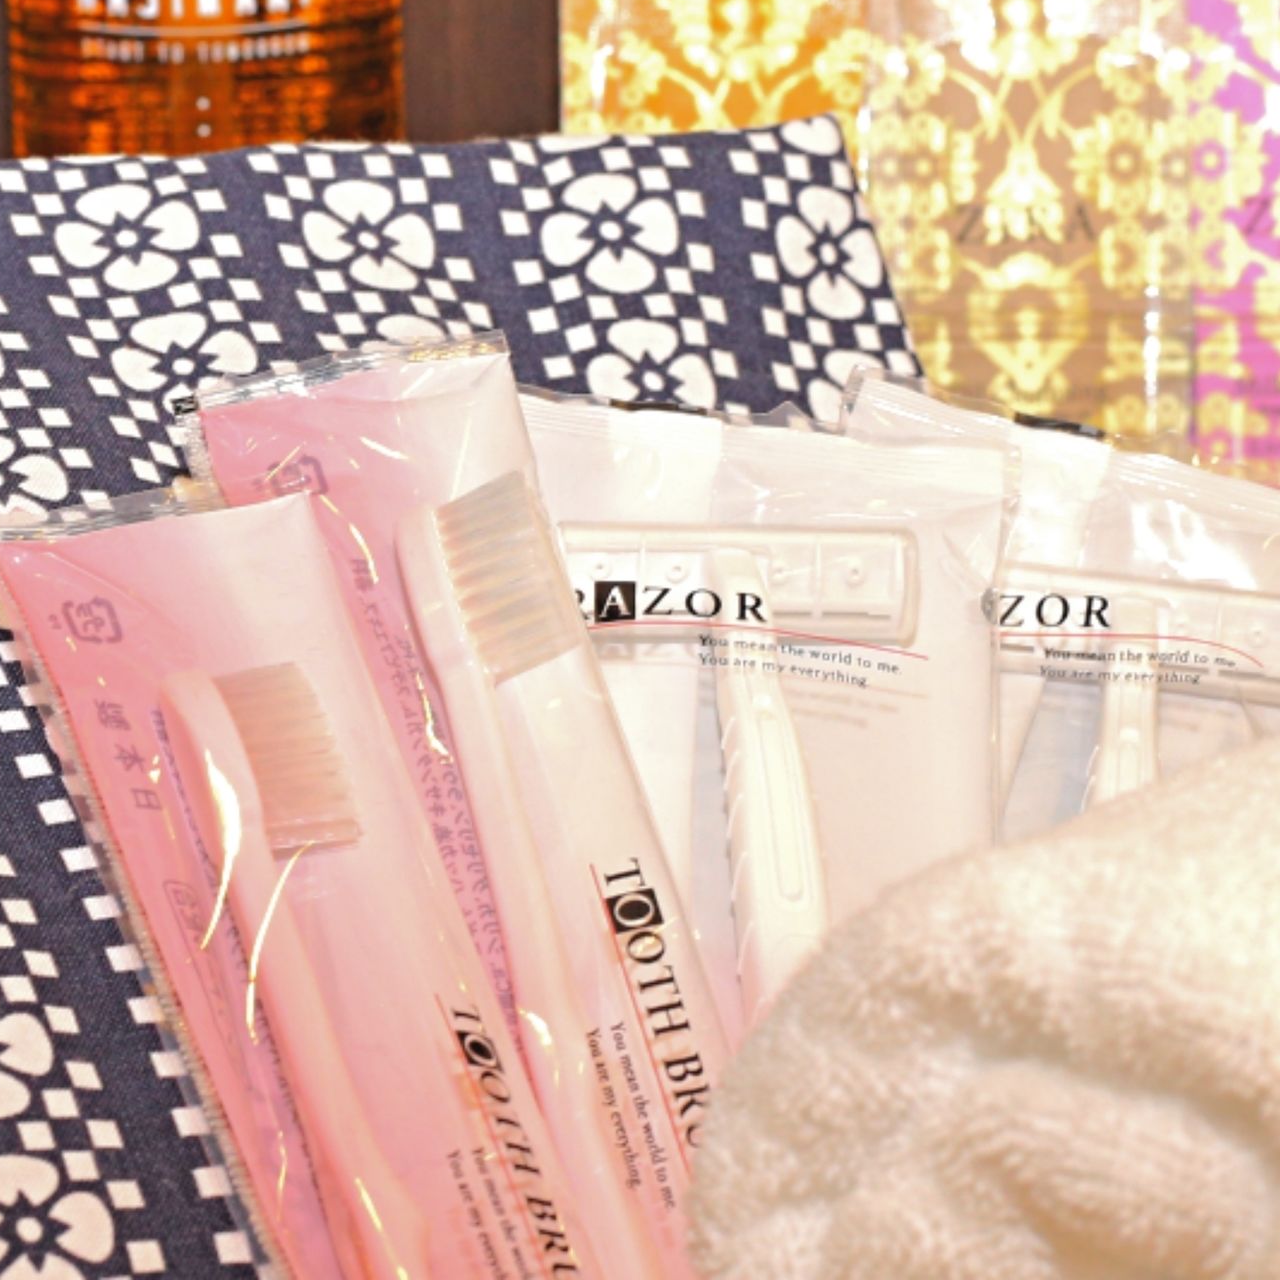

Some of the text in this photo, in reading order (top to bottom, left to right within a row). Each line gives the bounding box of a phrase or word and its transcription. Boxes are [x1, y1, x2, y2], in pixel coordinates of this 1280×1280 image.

[996, 594, 1110, 628] ZOR
[699, 634, 728, 648] You
[733, 639, 778, 653] mean
[780, 644, 806, 657] the
[809, 646, 852, 666] world
[857, 656, 871, 668] to
[699, 653, 729, 666] You
[733, 657, 757, 668] are
[762, 660, 784, 673] my
[1119, 650, 1142, 662] the
[1146, 650, 1188, 664] world
[1194, 654, 1208, 664] to
[1040, 665, 1065, 678] You
[1070, 669, 1092, 679] are
[1098, 671, 1120, 682] my
[604, 857, 692, 1038] TOOTH
[585, 1028, 601, 1059] You
[595, 1060, 609, 1084] are
[451, 1005, 541, 1176] TOOTH
[601, 1084, 618, 1109] my
[609, 1022, 626, 1053] You
[619, 1054, 641, 1094] mean
[632, 1094, 649, 1120] the
[643, 1120, 668, 1166] world
[656, 1164, 669, 1184] to
